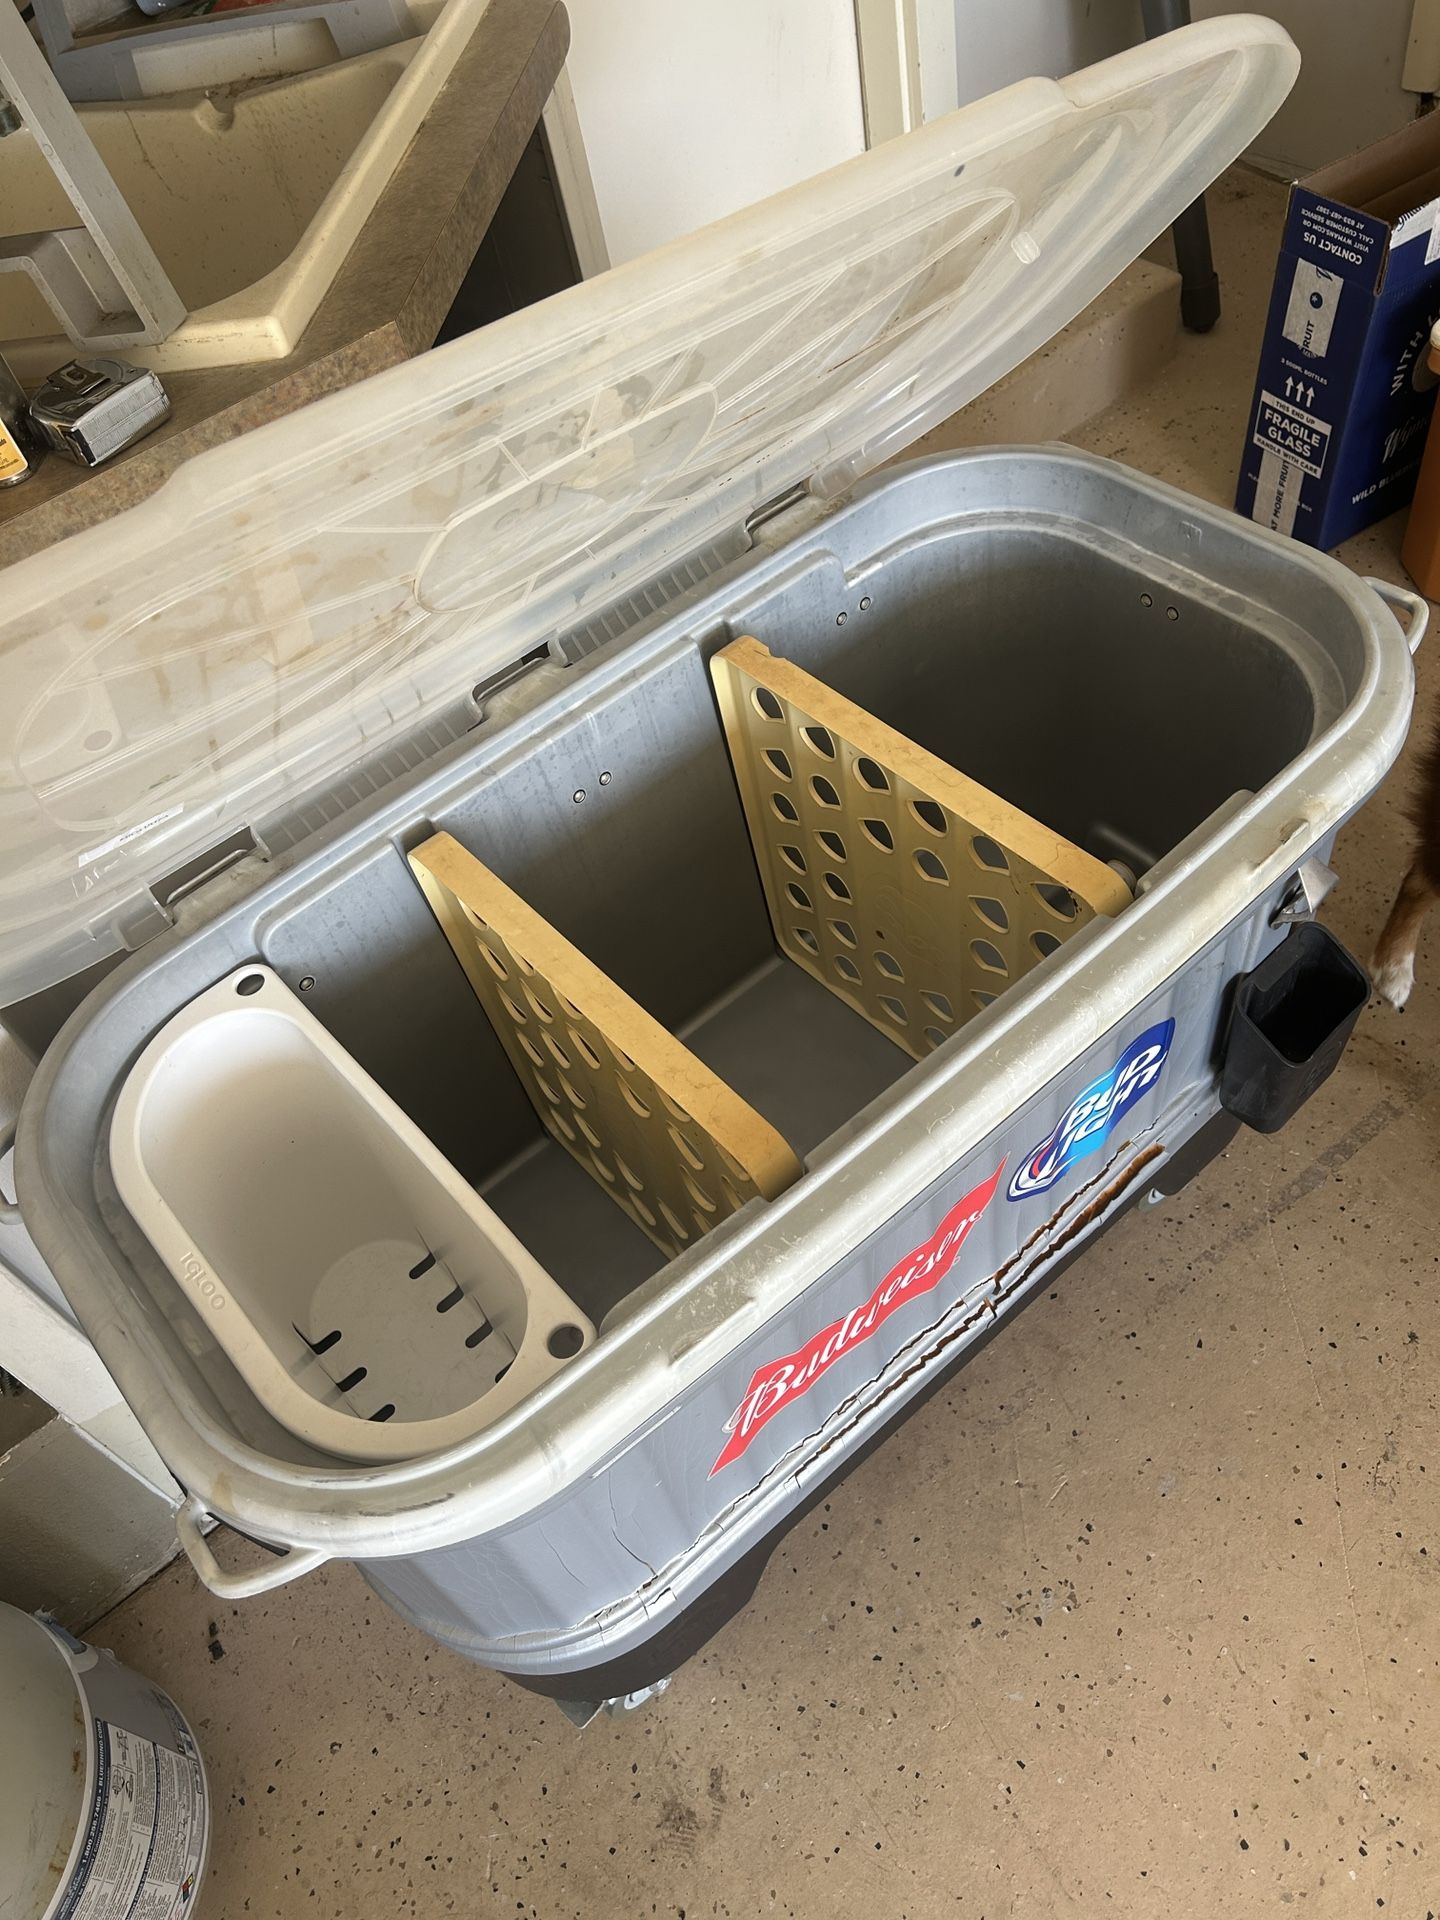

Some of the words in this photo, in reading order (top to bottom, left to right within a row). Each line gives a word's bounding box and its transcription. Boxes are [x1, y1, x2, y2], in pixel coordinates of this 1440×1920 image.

[1300, 208, 1325, 224] SERVICE
[1302, 218, 1312, 228] OR
[1325, 218, 1357, 237] CUSTOMER
[1356, 221, 1365, 230] AT
[1303, 231, 1317, 246] US
[1312, 223, 1353, 246] WYMANS.COM
[1358, 232, 1374, 245] CALL
[1318, 239, 1363, 265] CONTACT
[1353, 242, 1369, 253] VISIT
[1301, 320, 1315, 351] RUIT
[1390, 330, 1423, 397] WITH
[1303, 368, 1328, 386] BOTTLES
[1275, 400, 1290, 414] THIS
[1291, 409, 1305, 421] END
[1305, 415, 1316, 426] UP
[1264, 408, 1321, 447] FRAGILE
[1267, 427, 1311, 458] GLASS
[1256, 437, 1282, 455] HANDLE
[1282, 450, 1300, 466] WITH
[1300, 460, 1318, 475] CARE
[1273, 488, 1284, 518] MORE
[1351, 484, 1377, 505] WILD
[1269, 519, 1278, 532] AT
[1059, 1045, 1162, 1142] BUD
[1036, 1051, 1168, 1180] LIGHT
[722, 1211, 984, 1436] Budweiser
